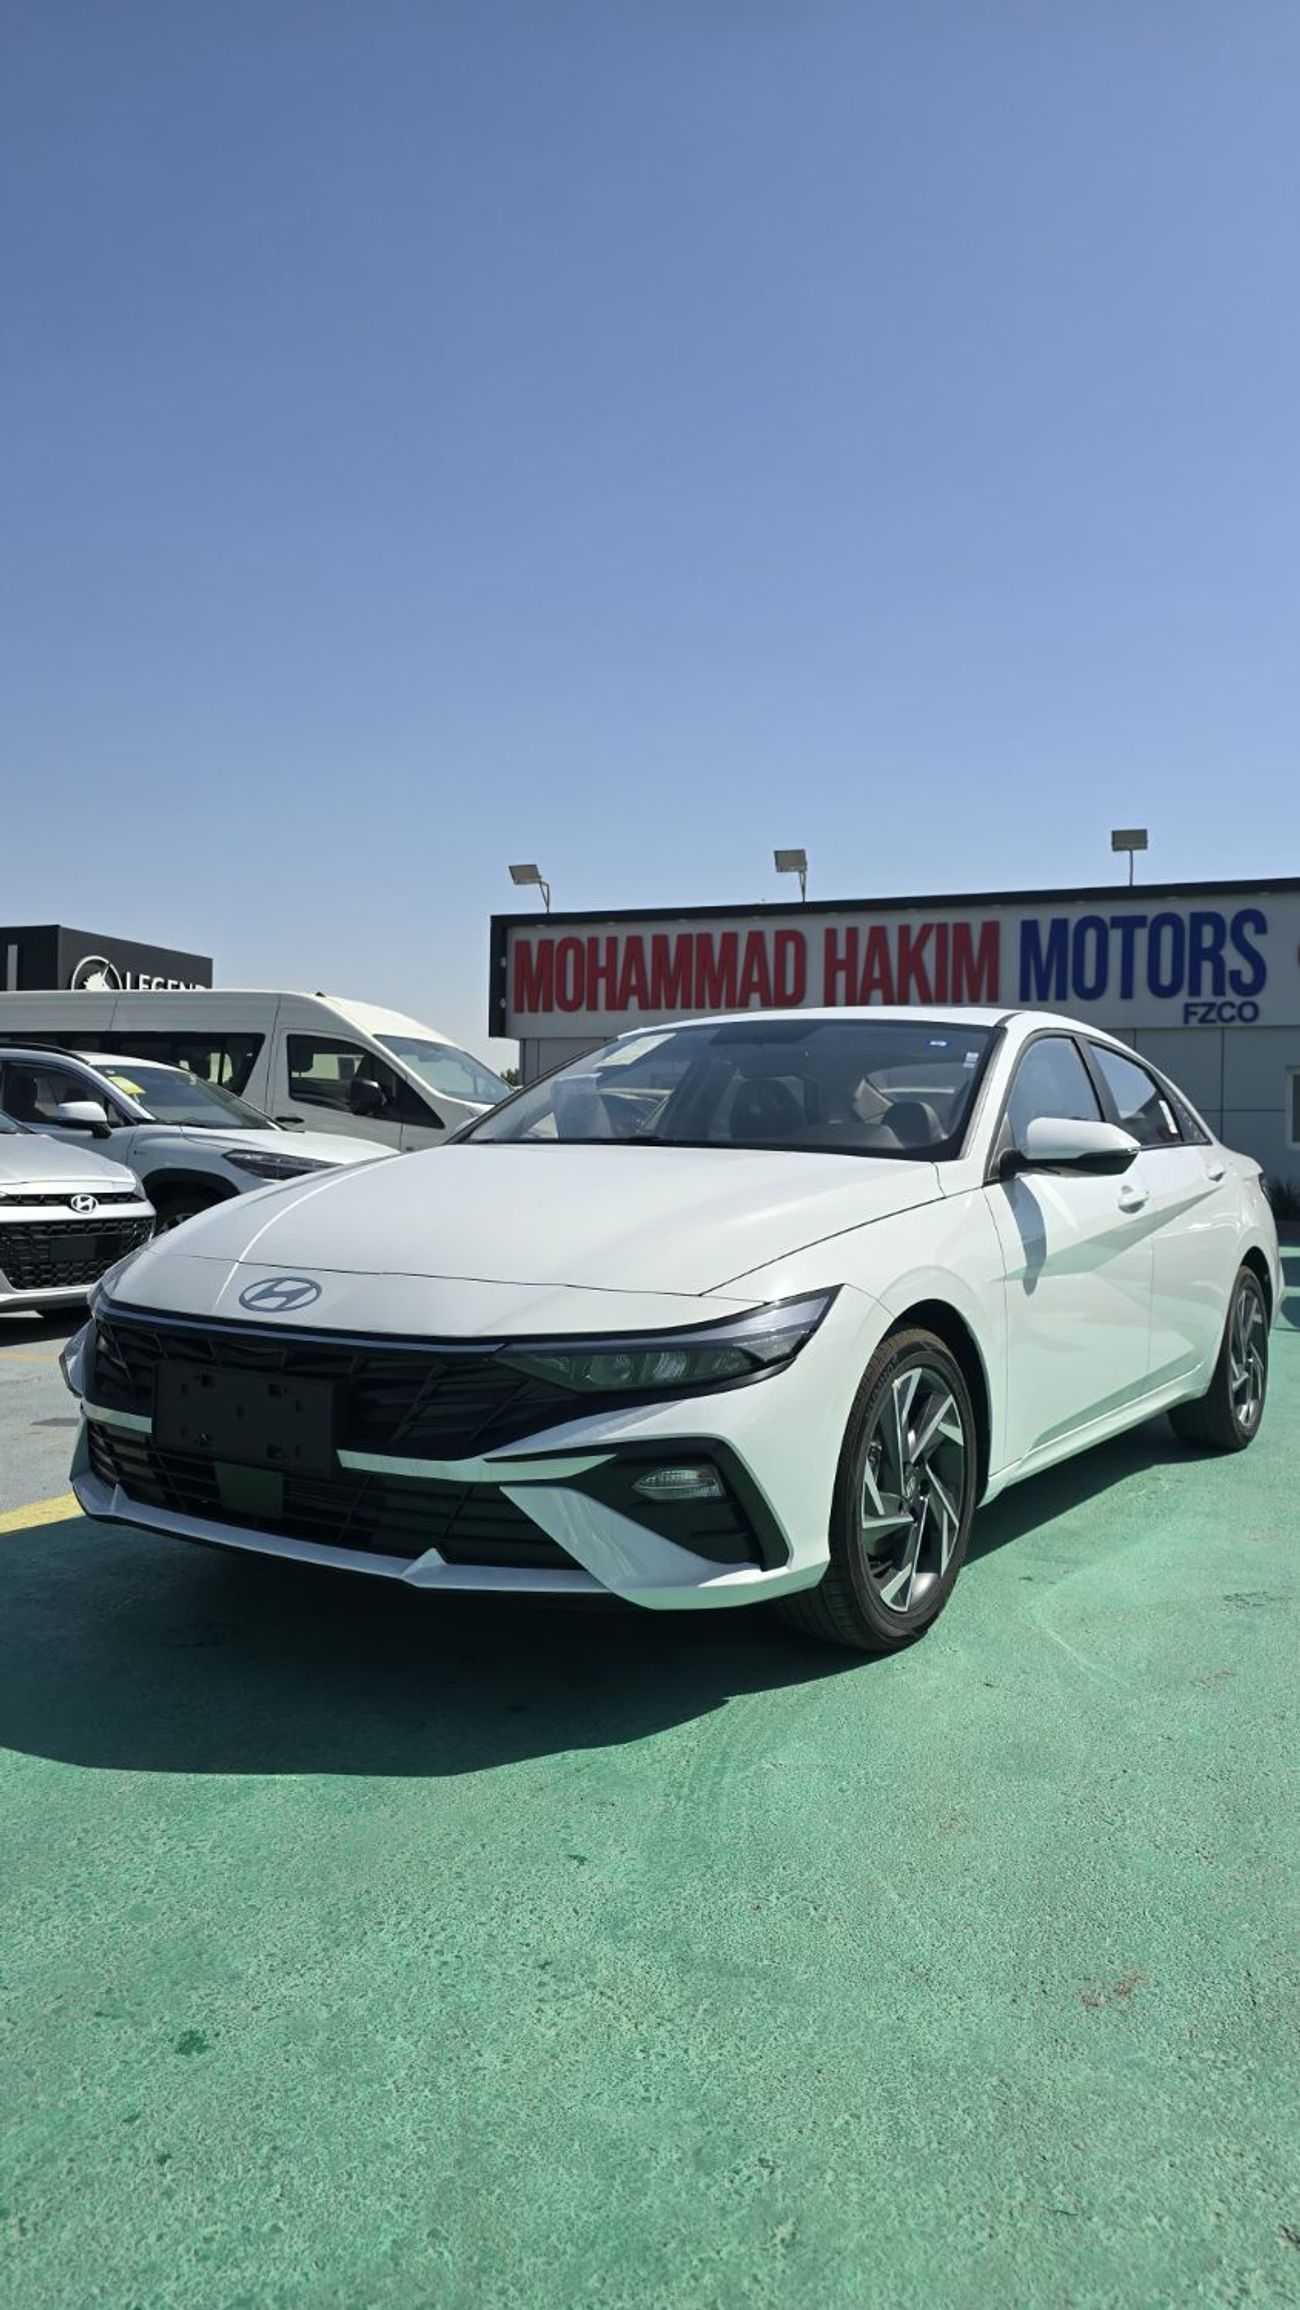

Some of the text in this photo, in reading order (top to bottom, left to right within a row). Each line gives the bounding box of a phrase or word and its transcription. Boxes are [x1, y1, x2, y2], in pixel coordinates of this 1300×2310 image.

[513, 908, 1268, 1014] MOHAMMAD HAKIM MOTORS
[125, 971, 207, 990] LEG
[1183, 1001, 1260, 1024] FZCO
